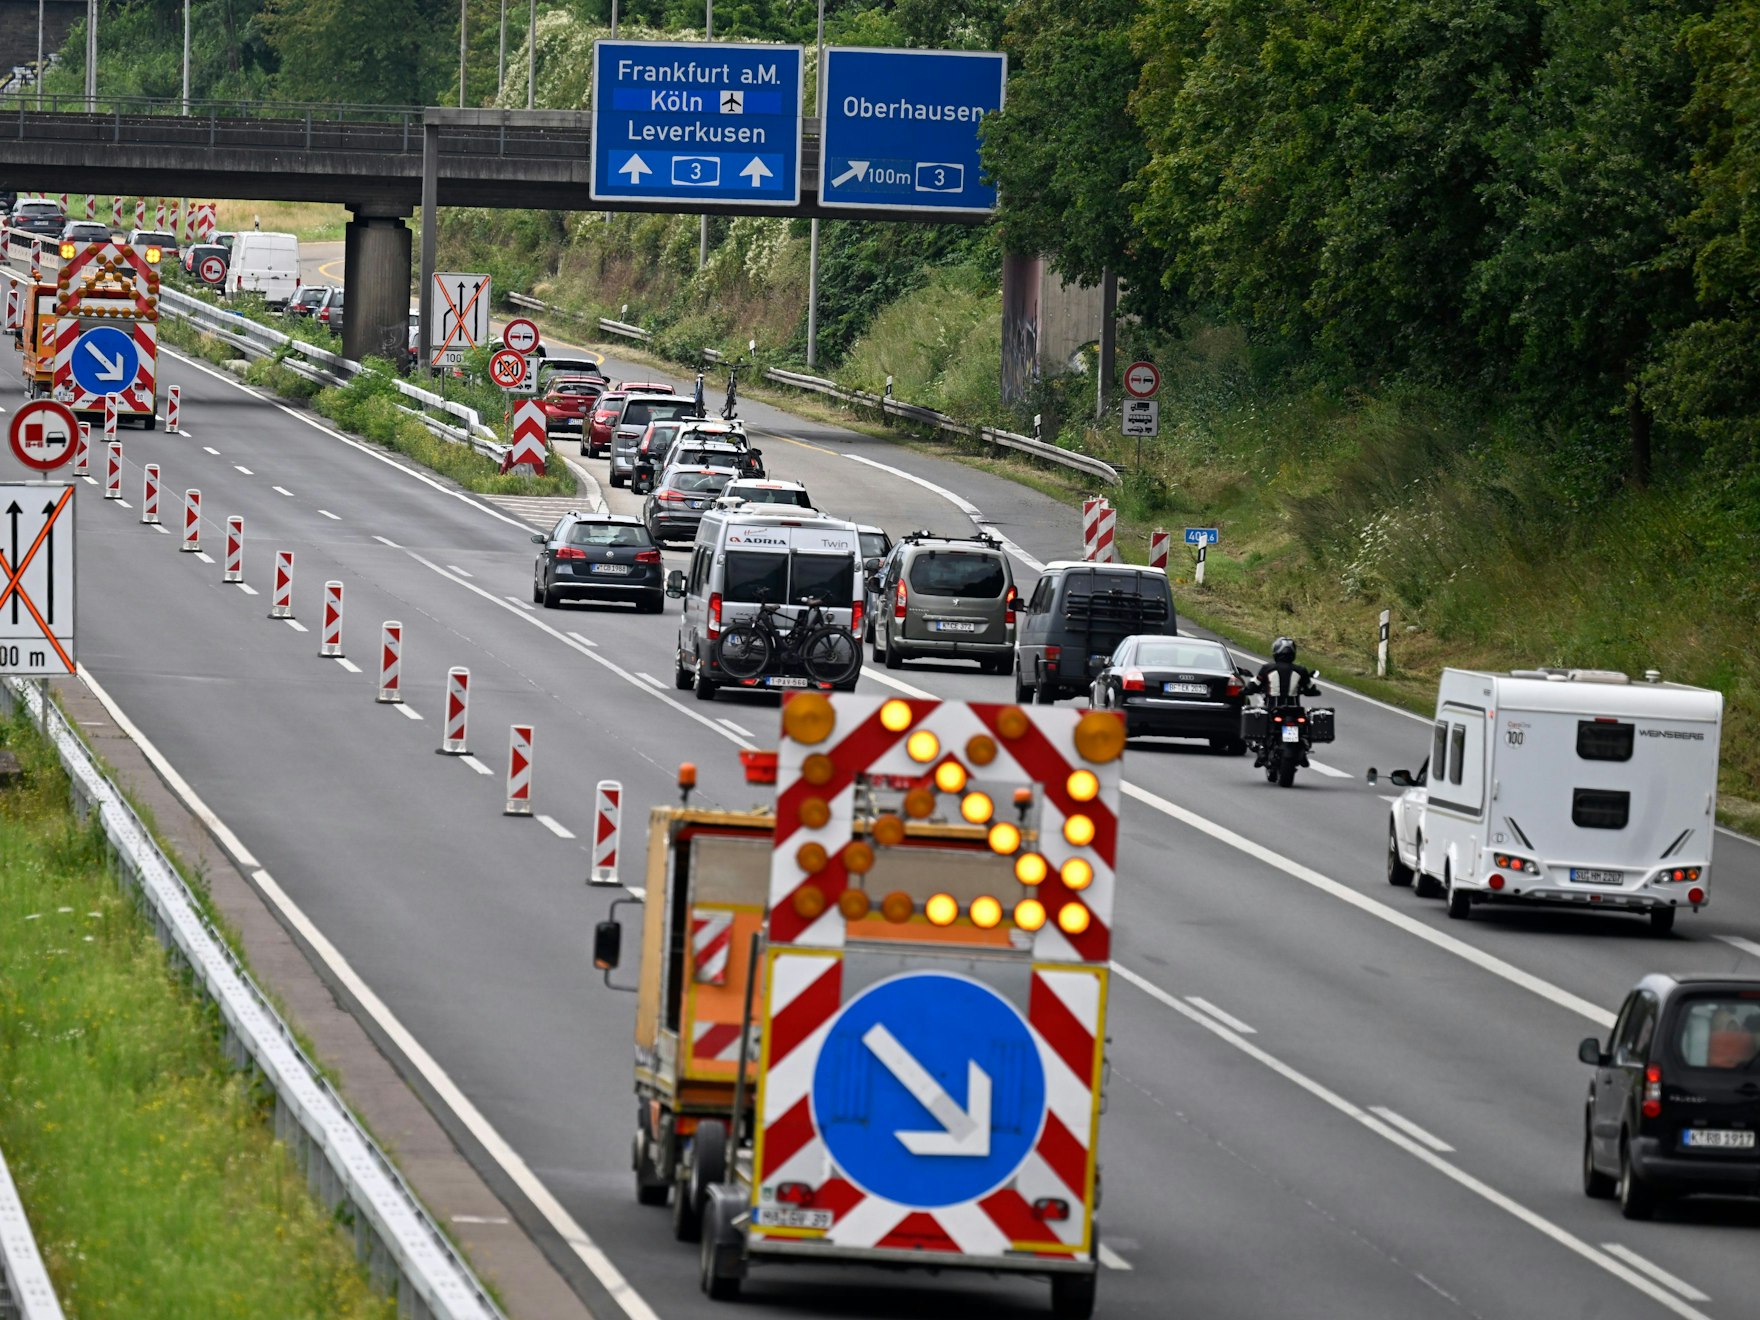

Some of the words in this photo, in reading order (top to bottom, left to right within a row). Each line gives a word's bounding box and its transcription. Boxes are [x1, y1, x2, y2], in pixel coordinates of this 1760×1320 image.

[618, 60, 730, 84] Frankfurt
[740, 63, 781, 84] a.M.
[651, 90, 703, 112] Köln
[843, 96, 985, 123] Oberhausen
[628, 120, 766, 144] Leverkusen
[690, 163, 702, 180] 3
[868, 168, 911, 185] 100m
[934, 169, 945, 186] 3
[743, 537, 787, 545] ADRIA
[821, 538, 848, 548] Twin
[30, 651, 45, 667] m
[1507, 731, 1523, 745] 100
[1639, 729, 1704, 740] WEINSBERG
